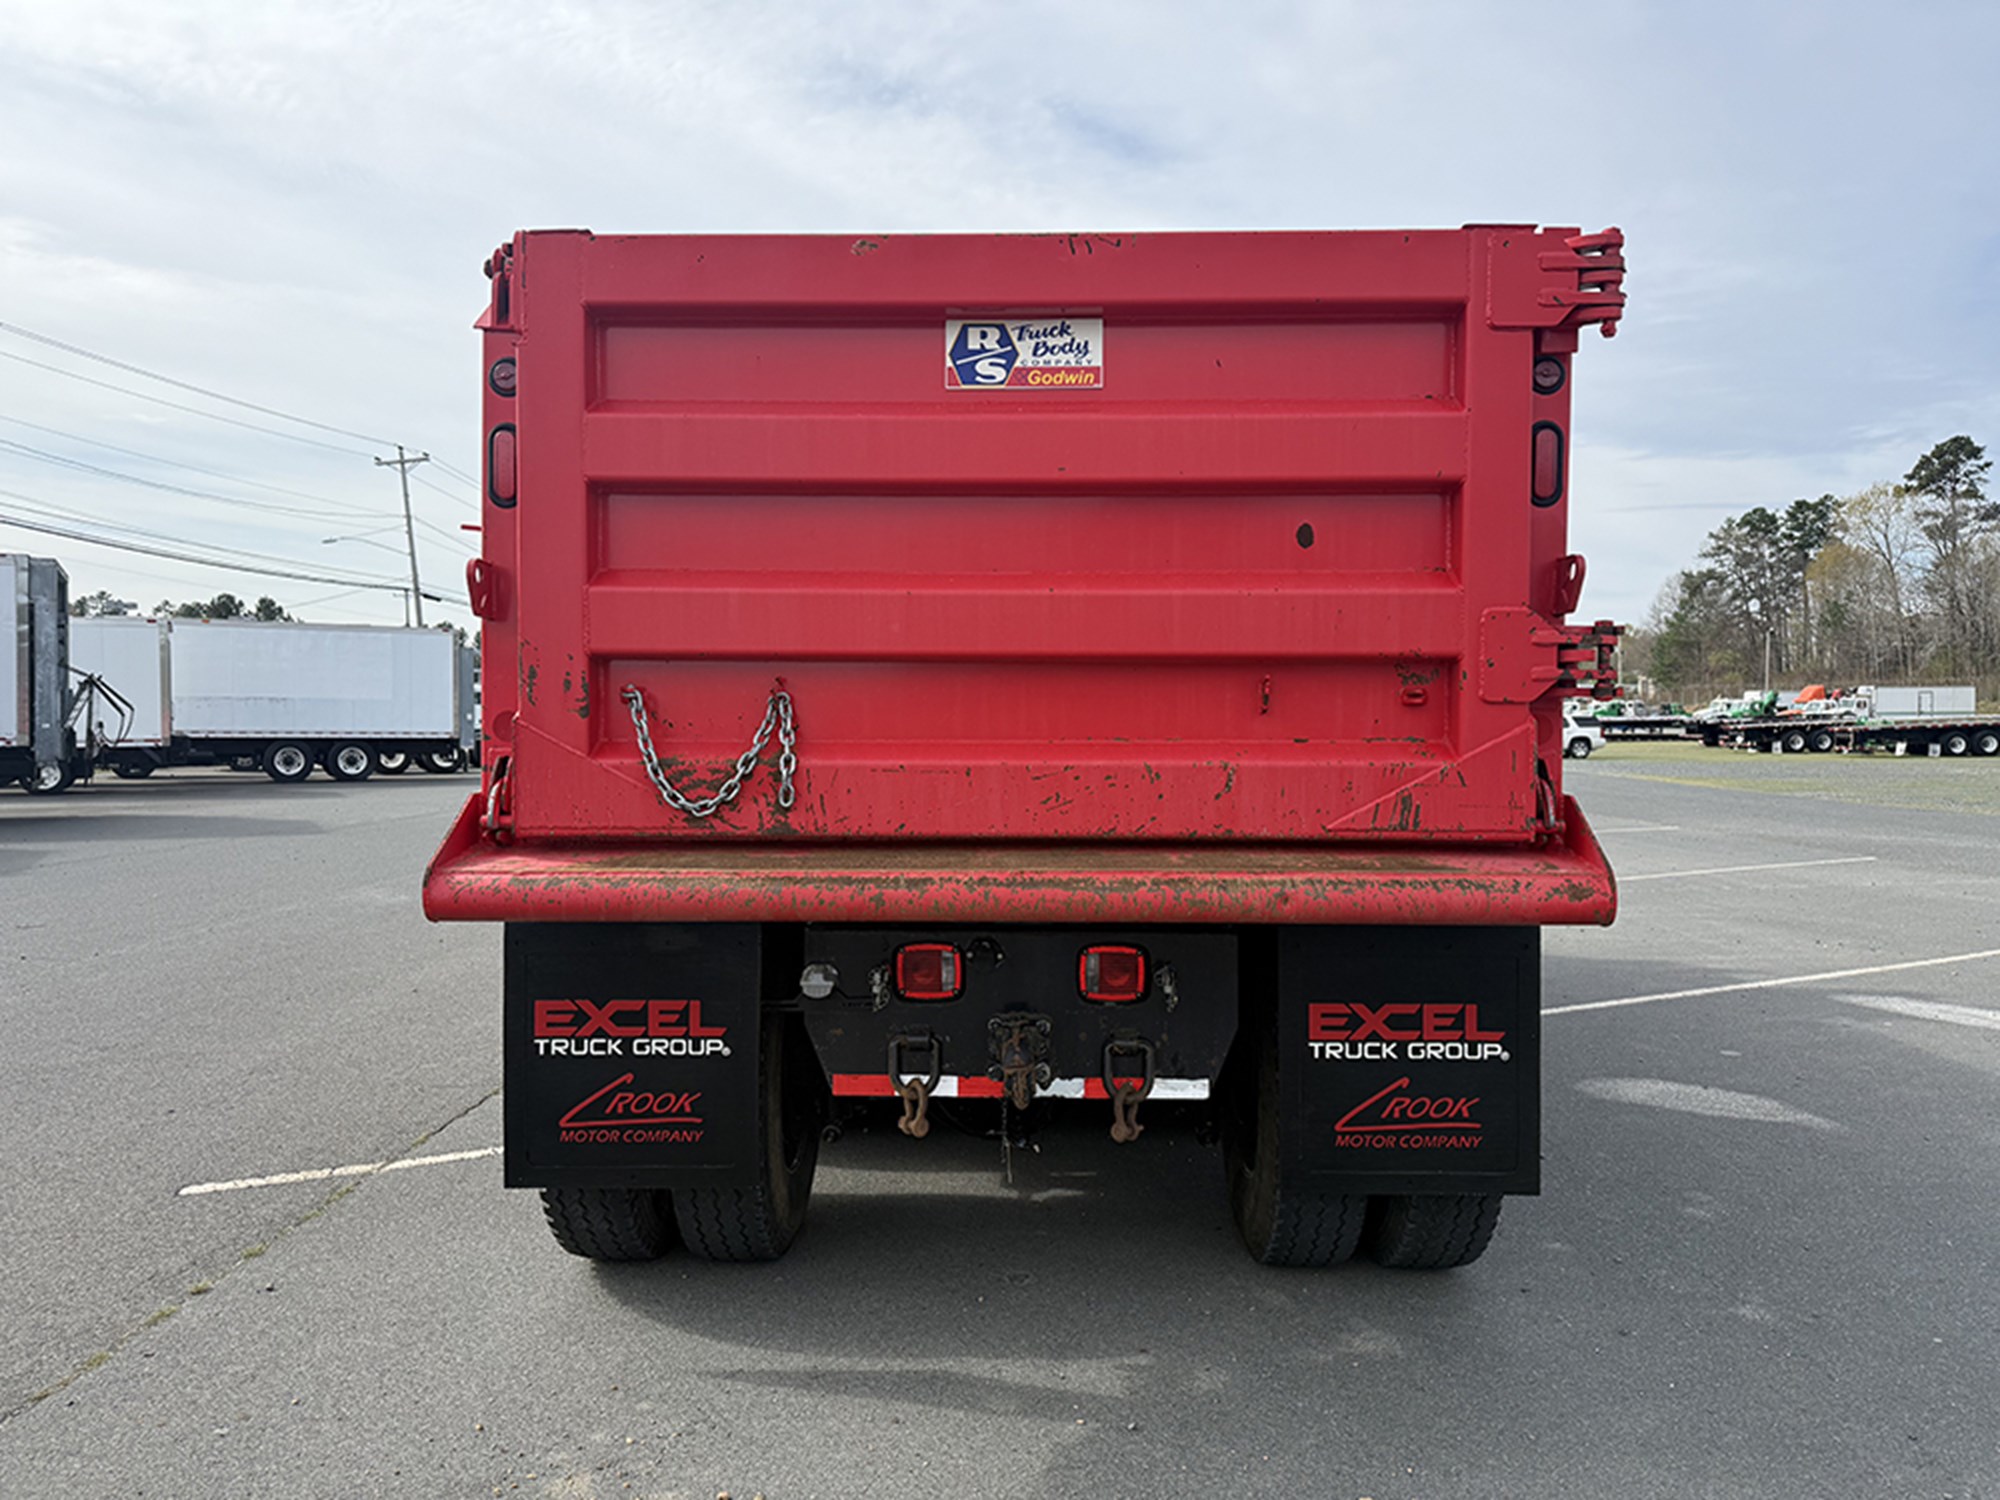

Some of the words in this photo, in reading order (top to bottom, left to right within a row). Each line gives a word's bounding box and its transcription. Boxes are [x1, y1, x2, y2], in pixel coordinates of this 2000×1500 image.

[1011, 320, 1072, 342] Truck
[1032, 337, 1090, 359] Body
[1027, 369, 1095, 385] Godwin
[533, 999, 727, 1037] EXCEL
[1308, 1003, 1506, 1041] EXCEL
[533, 1038, 623, 1056] TRUCK
[1308, 1042, 1398, 1059] TRUCK
[559, 1130, 620, 1143] MOTOR
[622, 1130, 704, 1143] COMPANY
[1335, 1135, 1397, 1148] MOTOR
[1399, 1135, 1483, 1148] COMPANY
